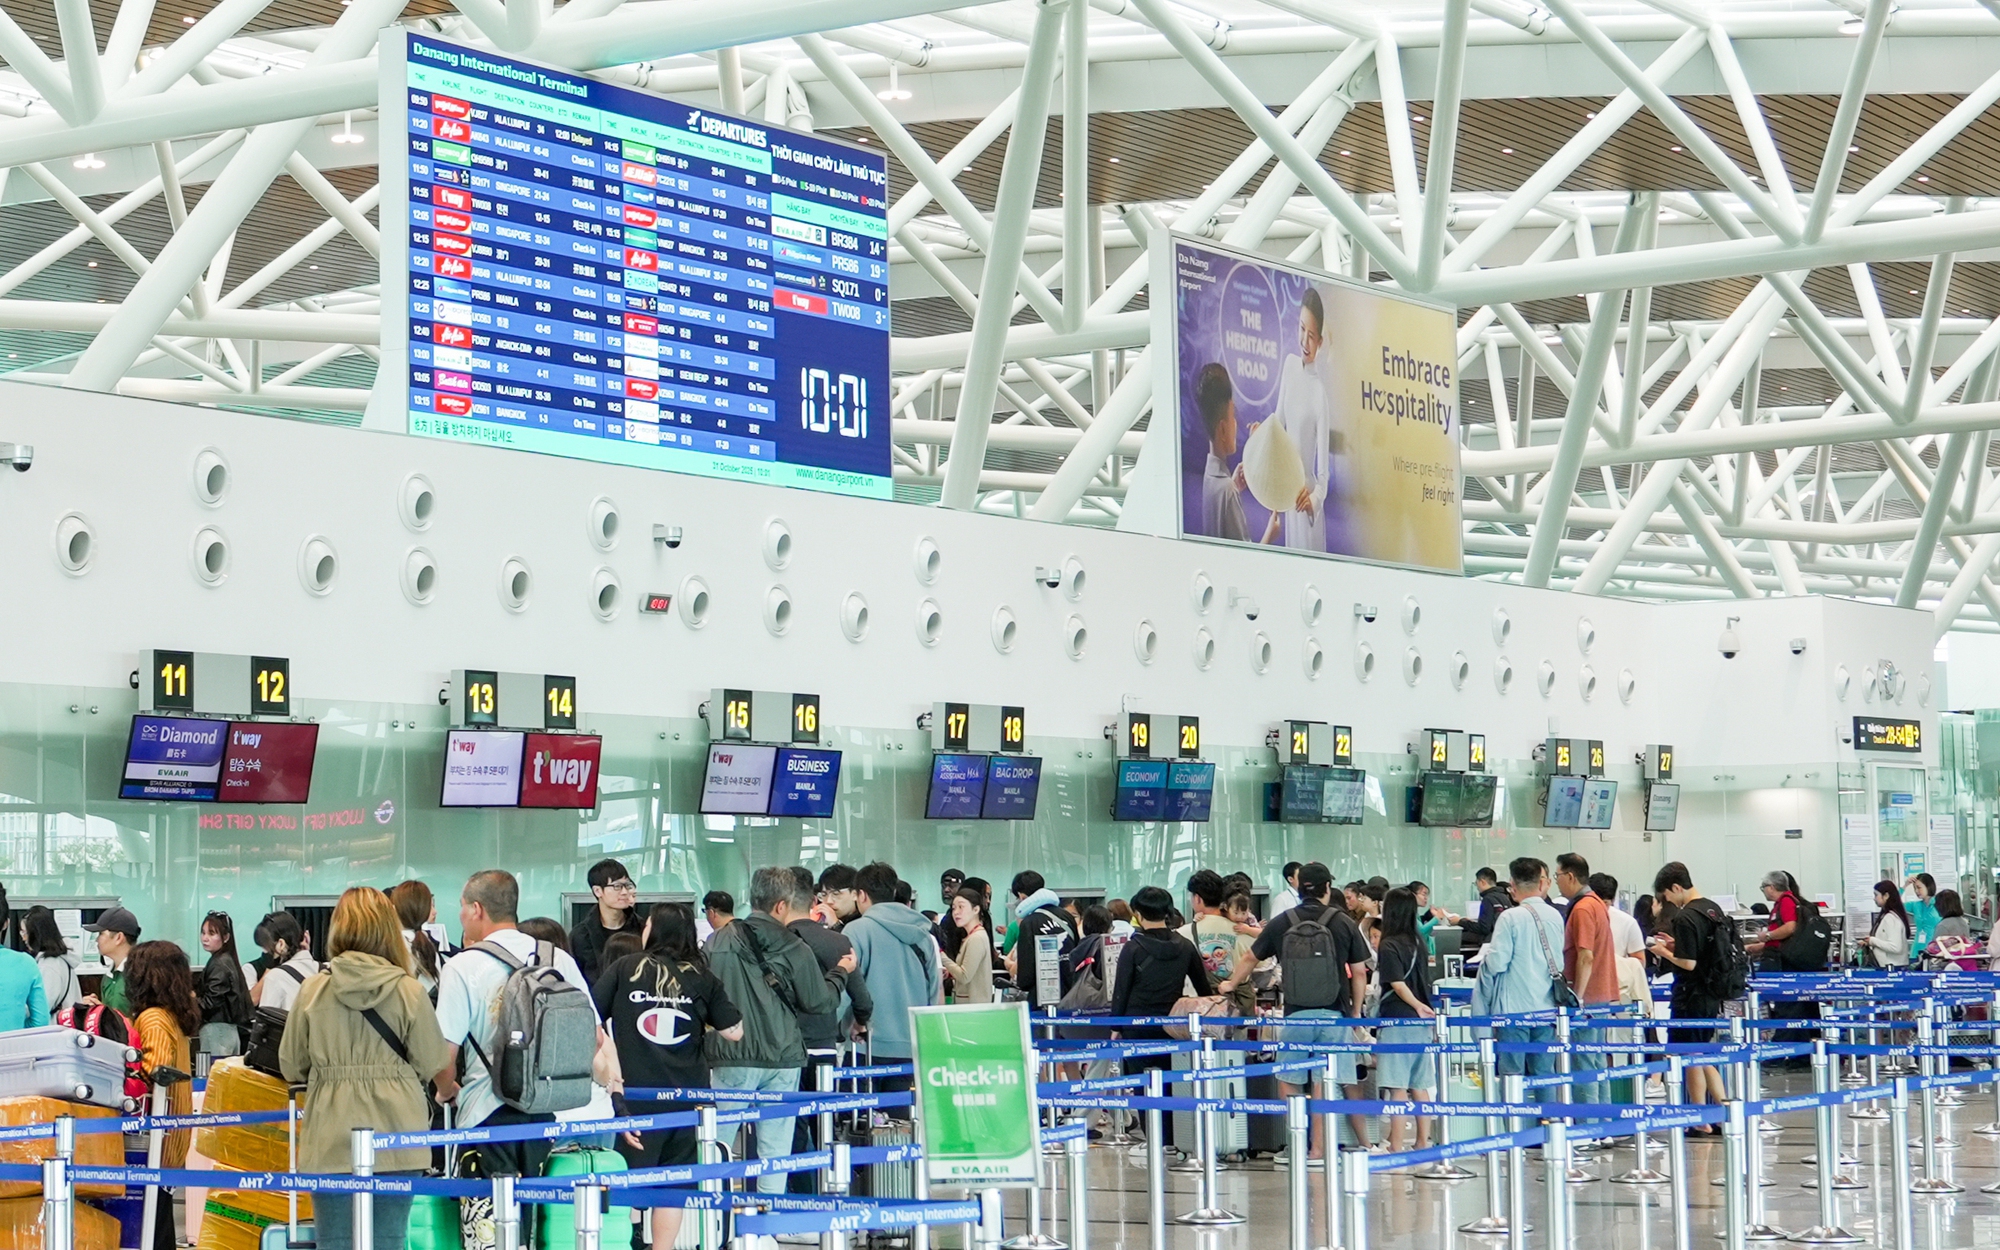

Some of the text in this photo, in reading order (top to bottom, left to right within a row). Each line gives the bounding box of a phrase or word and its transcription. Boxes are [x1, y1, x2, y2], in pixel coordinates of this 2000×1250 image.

[413, 42, 587, 98] Danang International Terminal
[571, 133, 592, 146] Delayed
[701, 116, 767, 148] DEPARTURES
[771, 144, 885, 186] THỜI GIAN CHỜ LÀM THỦ TỤC
[496, 181, 530, 198] SINGAPORE
[496, 226, 531, 242] SINGAPORE
[776, 226, 858, 250] EVA AIR BR384
[832, 255, 859, 273] PR586
[1178, 253, 1209, 271] Da Nang
[1179, 267, 1216, 284] International
[1179, 278, 1202, 292] Airport
[832, 279, 860, 298] SQ171
[832, 302, 860, 320] TW008
[1240, 308, 1262, 330] THE
[1226, 330, 1278, 358] HERITAGE
[1237, 358, 1268, 382] ROAD
[1382, 346, 1450, 388] Embrace
[801, 367, 867, 439] 10:01
[795, 467, 874, 487] www.danangairport.vn
[1392, 455, 1454, 483] Where pre-flight
[1422, 484, 1454, 506] feel right
[161, 663, 186, 696] 11
[257, 670, 285, 703] 12
[469, 683, 494, 713] 13
[548, 687, 572, 717] 14
[727, 700, 748, 729] 15
[795, 704, 816, 732] 16
[159, 726, 217, 745] Diamond
[948, 713, 966, 739] 17
[1004, 716, 1021, 742] 18
[1132, 723, 1147, 747] 19
[233, 730, 261, 748] t'way
[453, 739, 476, 755] t'way
[1181, 726, 1197, 749] 20
[1293, 732, 1307, 754] 21
[1336, 734, 1350, 757] 22
[712, 751, 733, 766] t'way
[1432, 740, 1446, 761] 23
[1470, 743, 1483, 764] 24
[1558, 746, 1569, 766] 25
[1591, 748, 1602, 767] 26
[533, 750, 591, 792] t'way
[787, 759, 830, 773] BUSINESS
[1660, 753, 1671, 771] 27
[940, 772, 966, 780] ASSISTANCE
[996, 768, 1033, 778] BAG DROP
[1126, 772, 1160, 782] ECONOMY
[1175, 774, 1207, 783] ECONOMY
[226, 779, 249, 787] Check-in
[795, 782, 815, 790] MANILA
[1040, 920, 1068, 934] NIK
[1930, 1047, 1946, 1055] Nang
[1947, 1047, 1988, 1055] International
[928, 1065, 1018, 1087] Check-in
[656, 1091, 782, 1101] AHT Da Nang International Terminal
[1053, 1098, 1128, 1107] International Terminal
[1383, 1104, 1541, 1115] AHT Da Nang International Terminal
[121, 1114, 241, 1131] AHT Da Nang International Terminal
[75, 1170, 161, 1181] International Terminal
[601, 1169, 692, 1186] Da Nang International Terminal
[951, 1166, 1009, 1174] EVA AIR
[239, 1176, 411, 1191] AHT Da Nang International Terminal
[830, 1208, 922, 1231] AHT Da Nang
